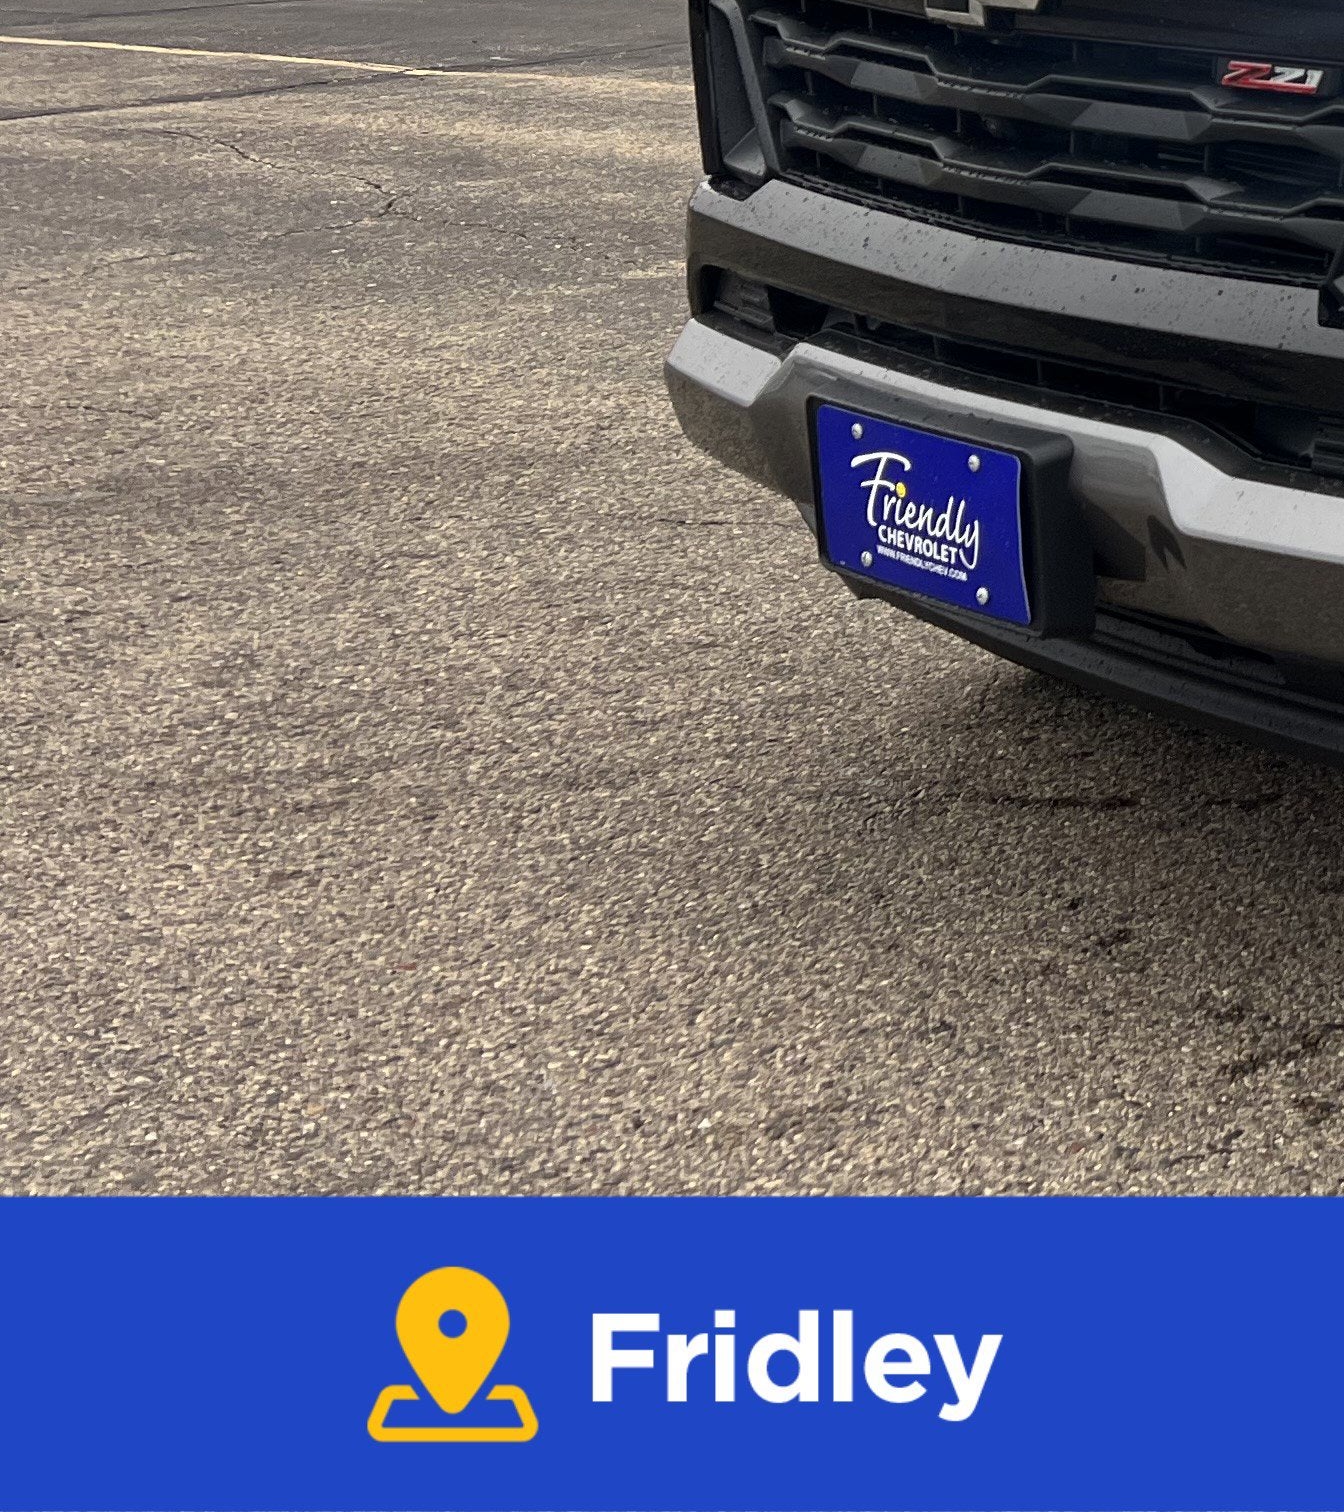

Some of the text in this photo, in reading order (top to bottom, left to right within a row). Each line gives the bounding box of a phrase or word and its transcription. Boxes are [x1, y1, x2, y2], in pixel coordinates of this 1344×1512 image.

[1221, 60, 1324, 95] Z71
[850, 452, 979, 570] Friendly
[878, 524, 958, 564] CHEVROLET
